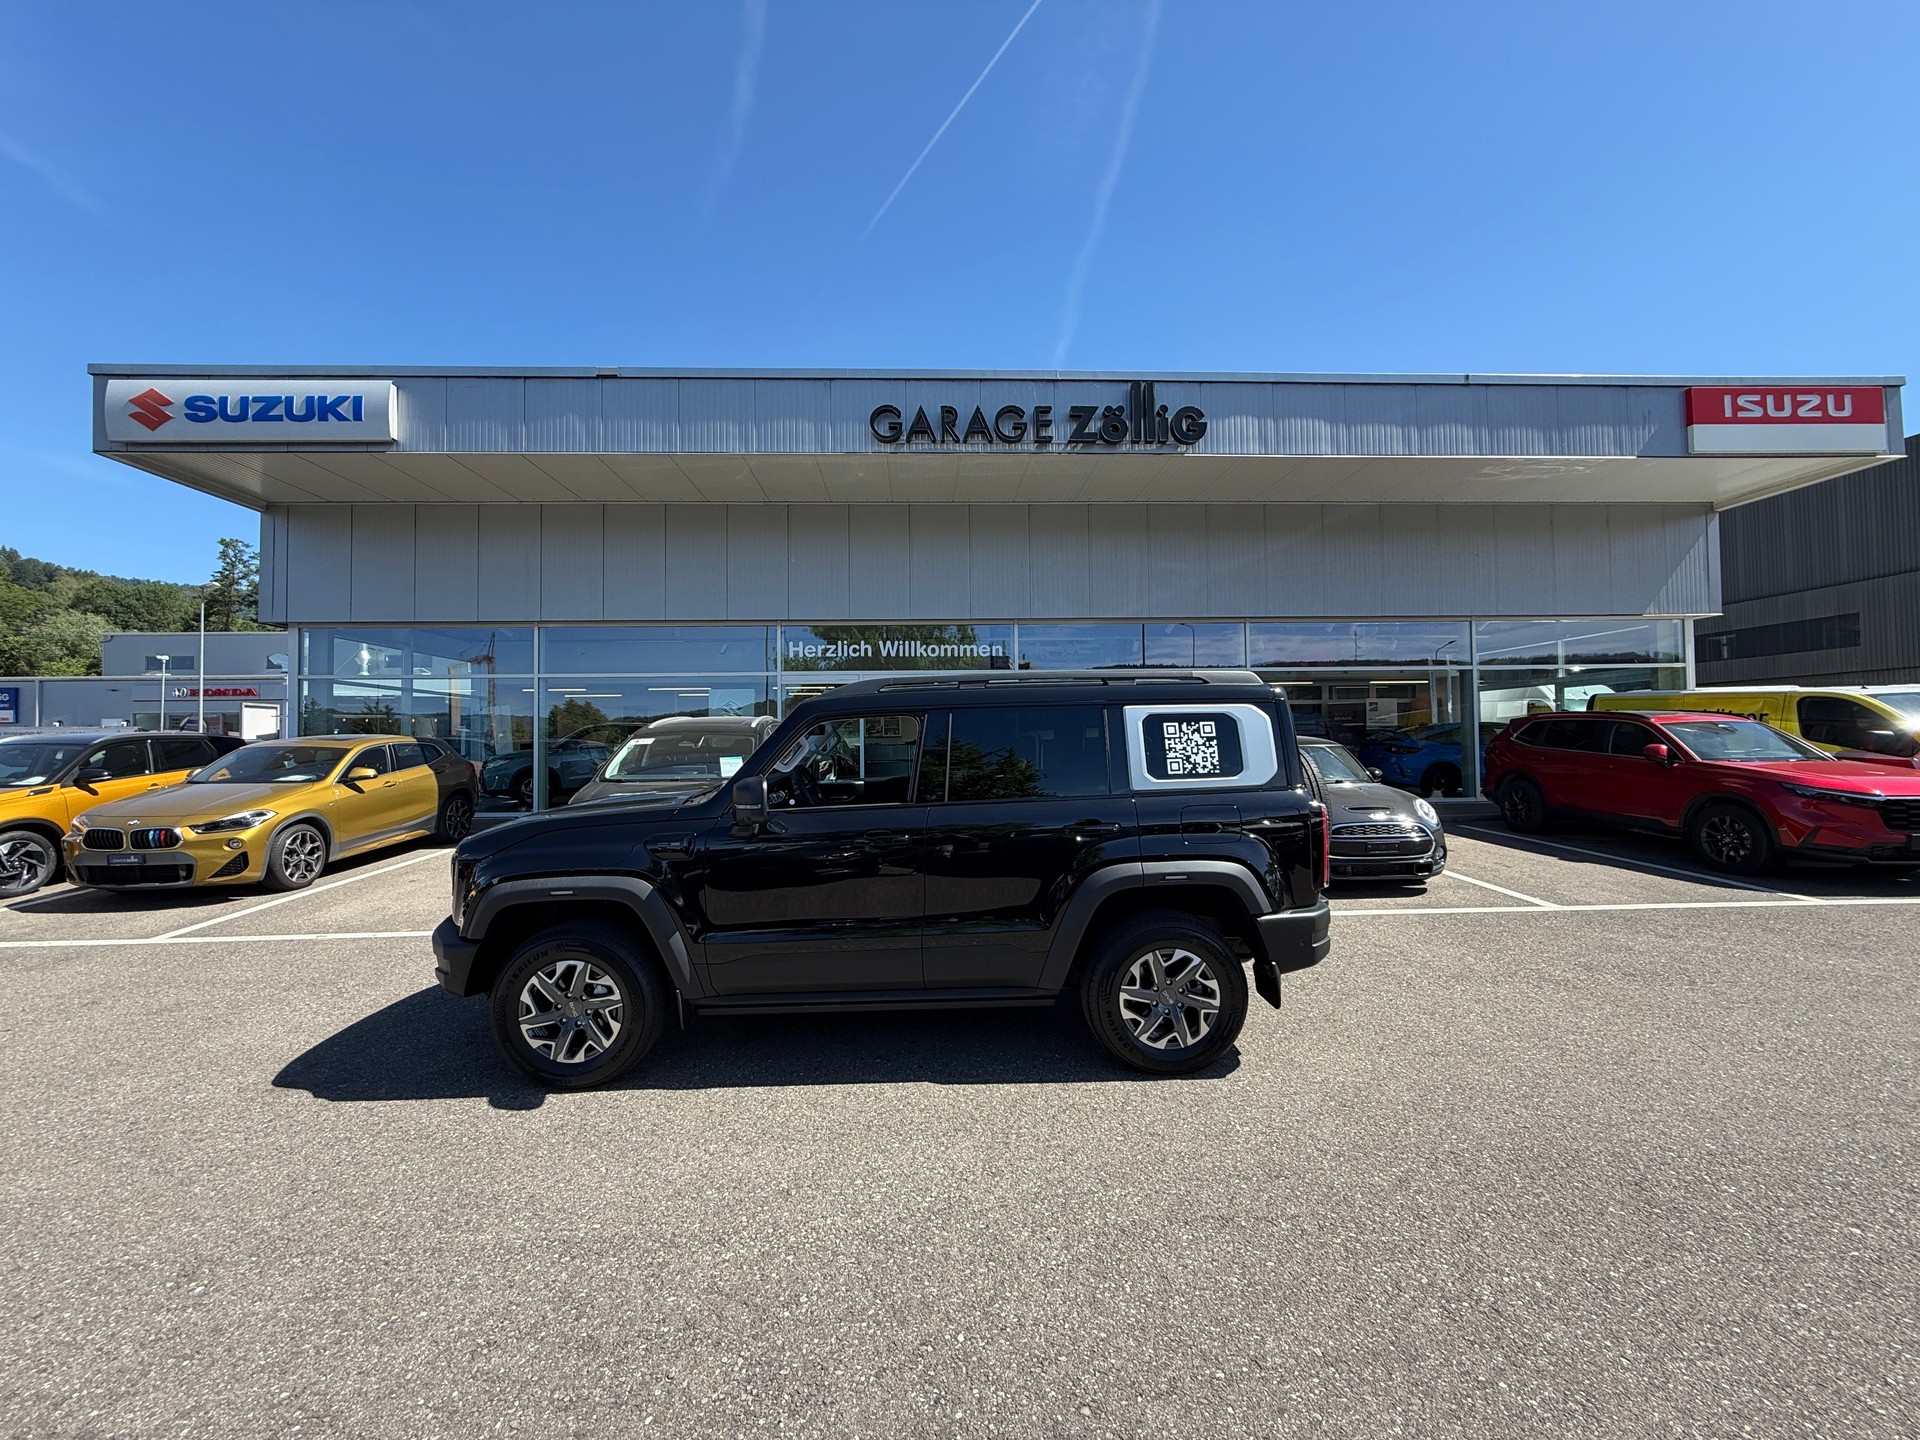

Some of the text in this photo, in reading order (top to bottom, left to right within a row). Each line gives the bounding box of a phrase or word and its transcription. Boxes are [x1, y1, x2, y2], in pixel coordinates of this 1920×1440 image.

[184, 395, 365, 423] SUZUKI
[1723, 394, 1853, 418] ISUZU
[870, 404, 1055, 444] GARAGE
[788, 640, 1004, 658] Herzlich Willkommen
[188, 688, 258, 697] HONDA
[513, 949, 549, 982] SAILUN
